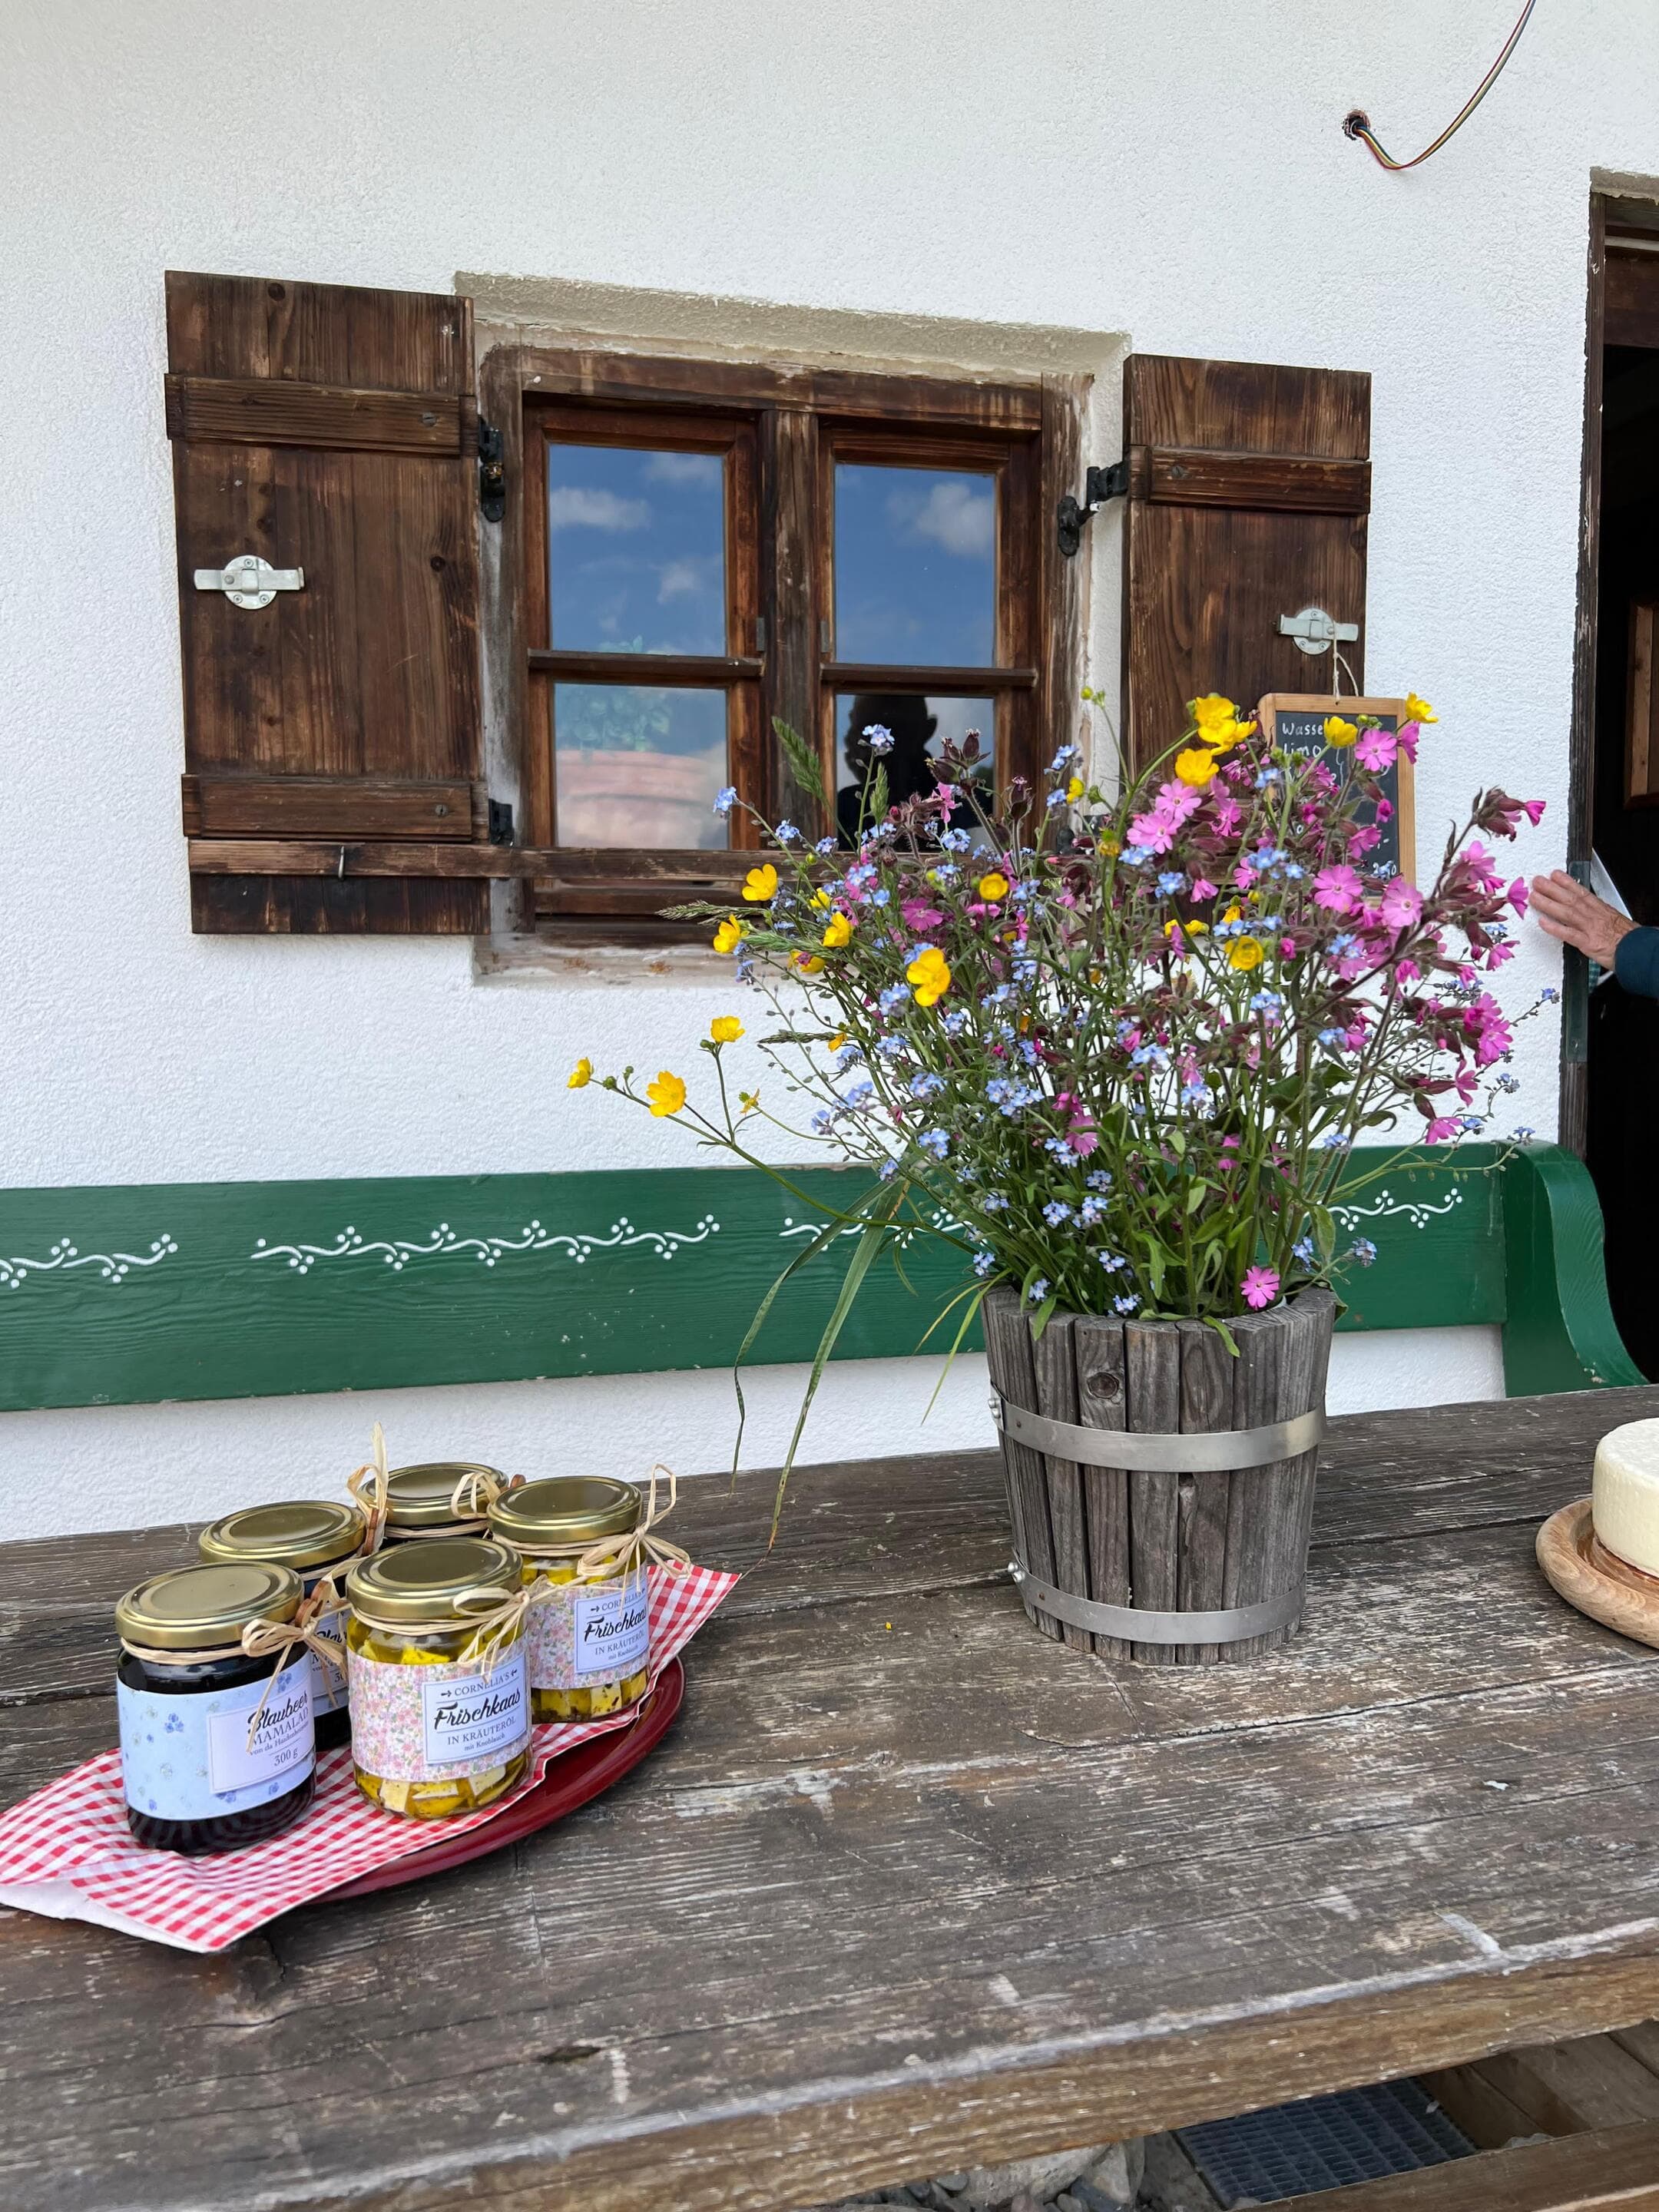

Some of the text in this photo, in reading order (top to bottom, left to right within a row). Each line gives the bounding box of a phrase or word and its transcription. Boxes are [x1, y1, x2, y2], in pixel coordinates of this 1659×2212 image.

[1282, 722, 1323, 735] Wasse
[584, 1604, 647, 1642] Frischkaas
[594, 1628, 645, 1655] IN KRÄUTERÖL
[454, 1671, 510, 1696] CORNELIA'S
[433, 1687, 521, 1730] Frischkaas
[446, 1716, 517, 1746] IN KRÄUTERÖL
[475, 1733, 505, 1748] Knoblauch
[264, 1743, 273, 1751] da
[273, 1747, 299, 1767] 300 g
